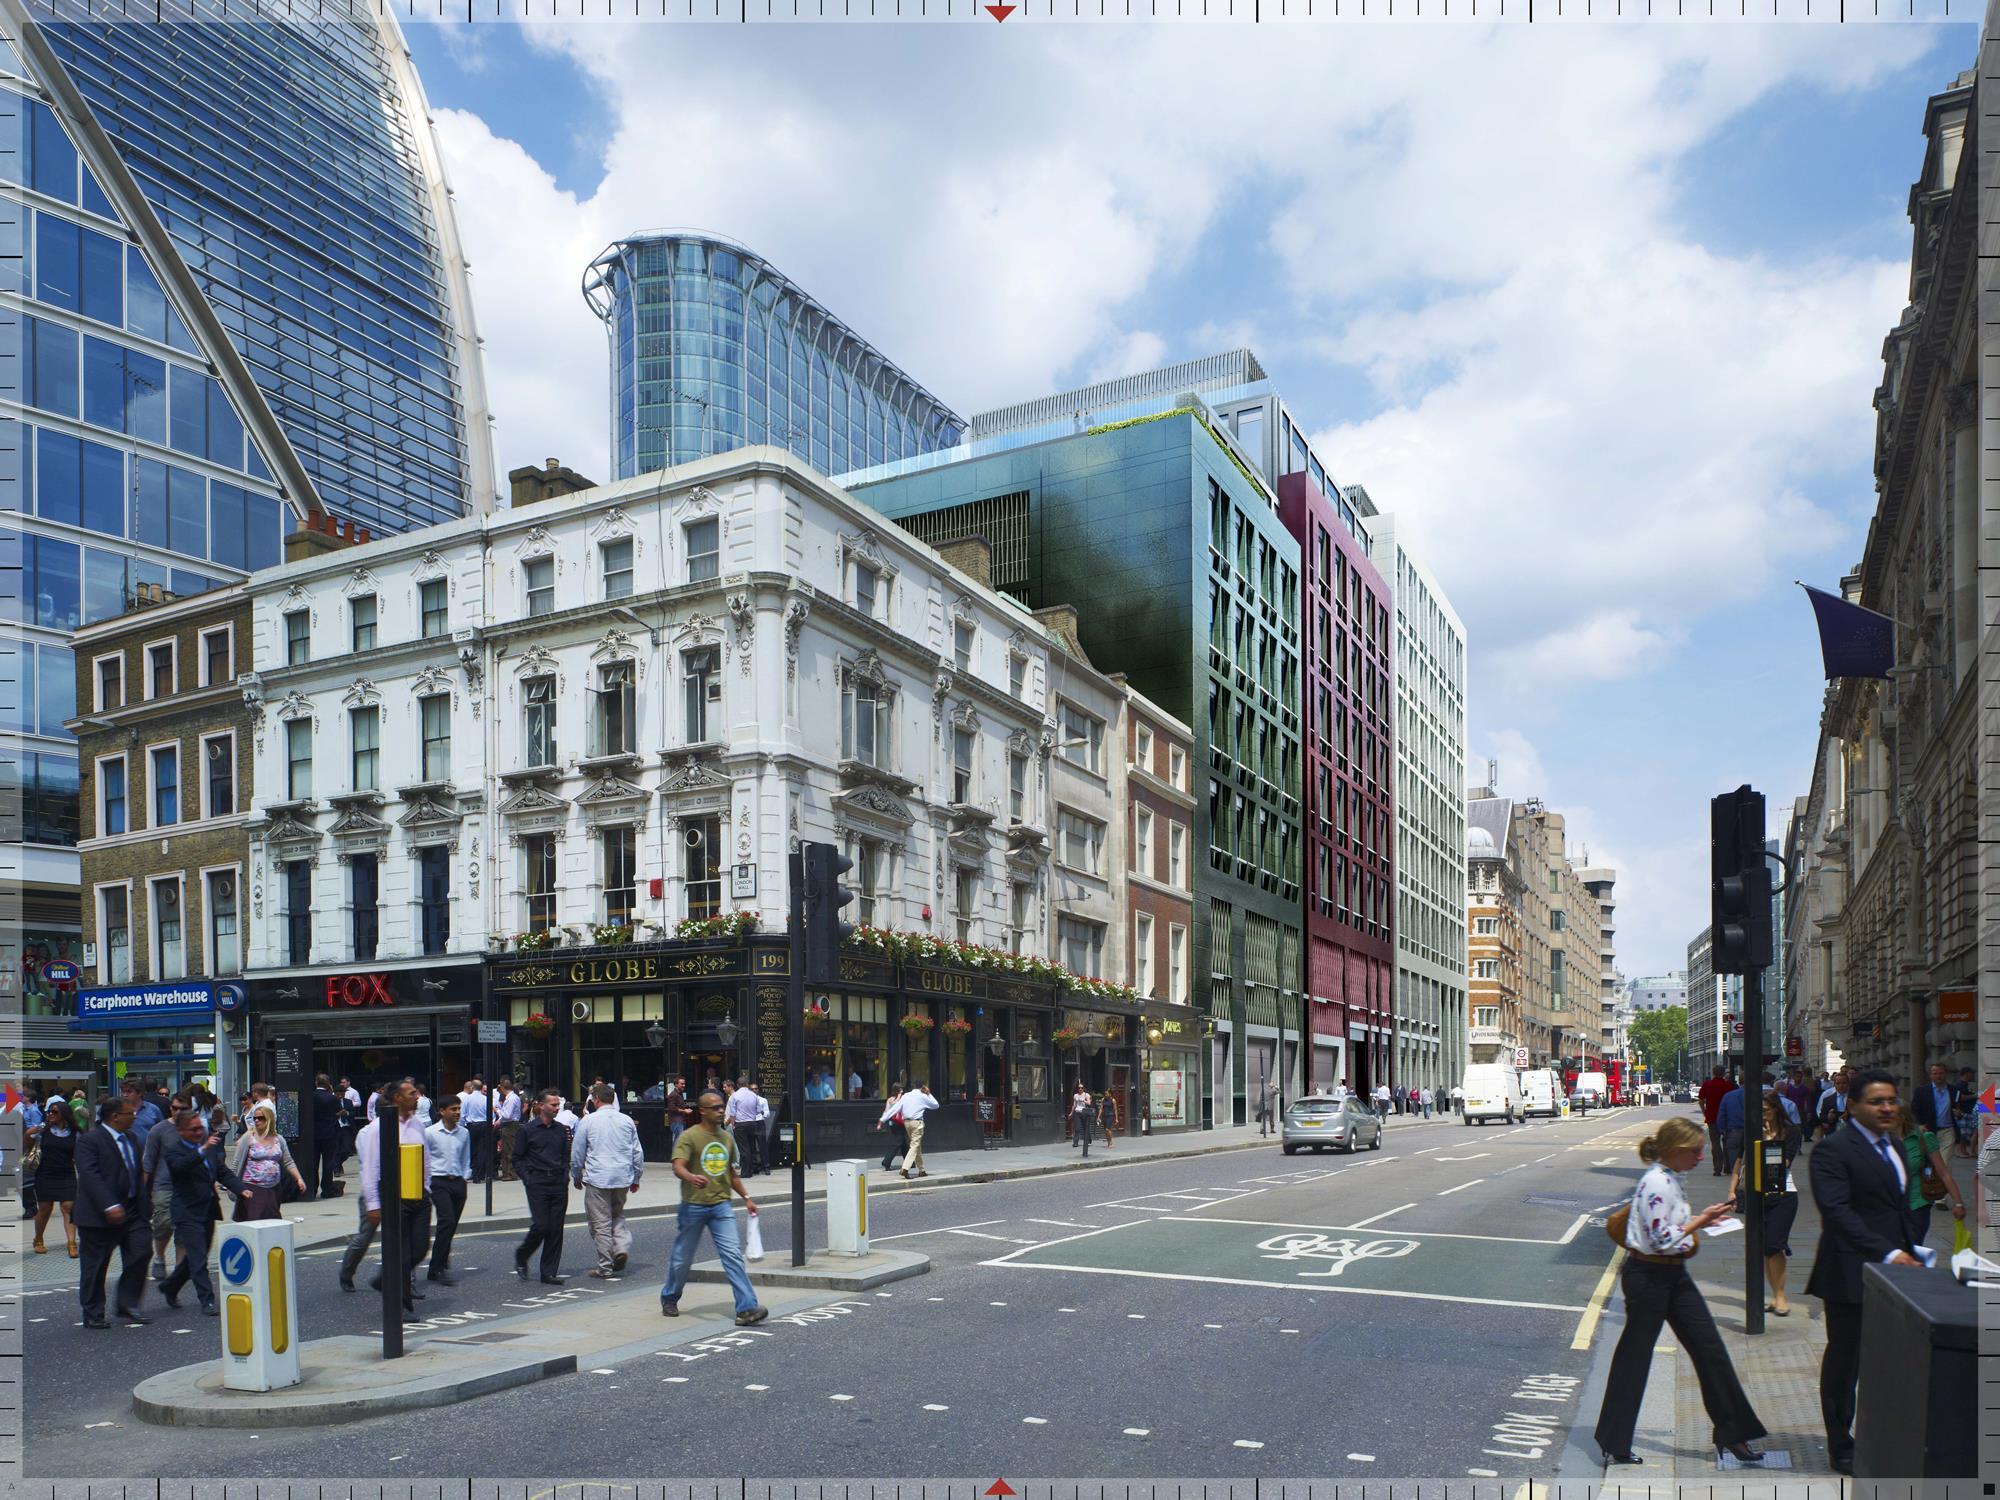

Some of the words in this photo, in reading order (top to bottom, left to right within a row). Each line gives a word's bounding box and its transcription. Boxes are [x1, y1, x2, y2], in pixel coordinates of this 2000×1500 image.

[570, 958, 658, 984] GLOBE
[761, 955, 784, 968] 199
[51, 970, 71, 979] HILL
[921, 970, 973, 994] GLOBE
[89, 994, 142, 1011] Carphone
[145, 990, 208, 1006] Warehouse
[221, 996, 234, 1005] HILL
[326, 974, 393, 1008] FOX
[1162, 1017, 1182, 1035] JONES
[9, 1061, 41, 1069] look
[502, 1287, 604, 1308] LEFT
[770, 1301, 871, 1326] LOOK
[656, 1330, 774, 1362] LEFT
[1482, 1411, 1561, 1459] LOOK
